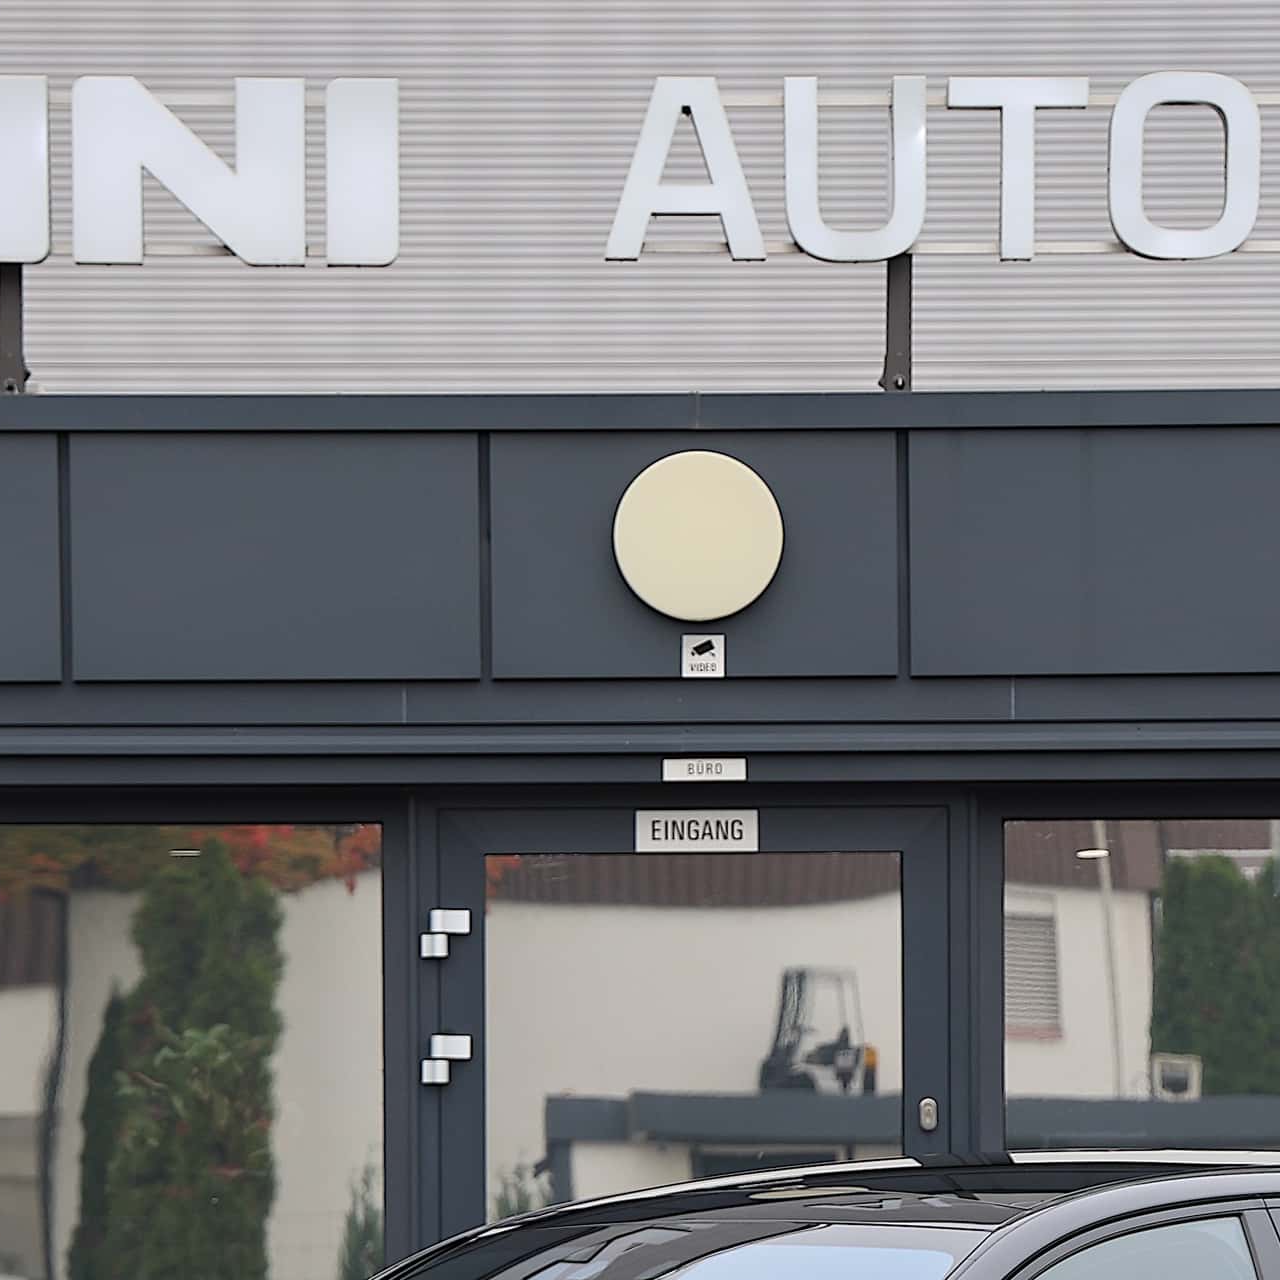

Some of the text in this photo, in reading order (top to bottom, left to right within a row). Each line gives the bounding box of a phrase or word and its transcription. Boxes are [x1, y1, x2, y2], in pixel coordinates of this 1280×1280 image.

[605, 70, 1262, 262] AUTO
[690, 662, 718, 672] VIDEO
[687, 760, 724, 775] BÜRO
[651, 819, 744, 841] EINGANG
